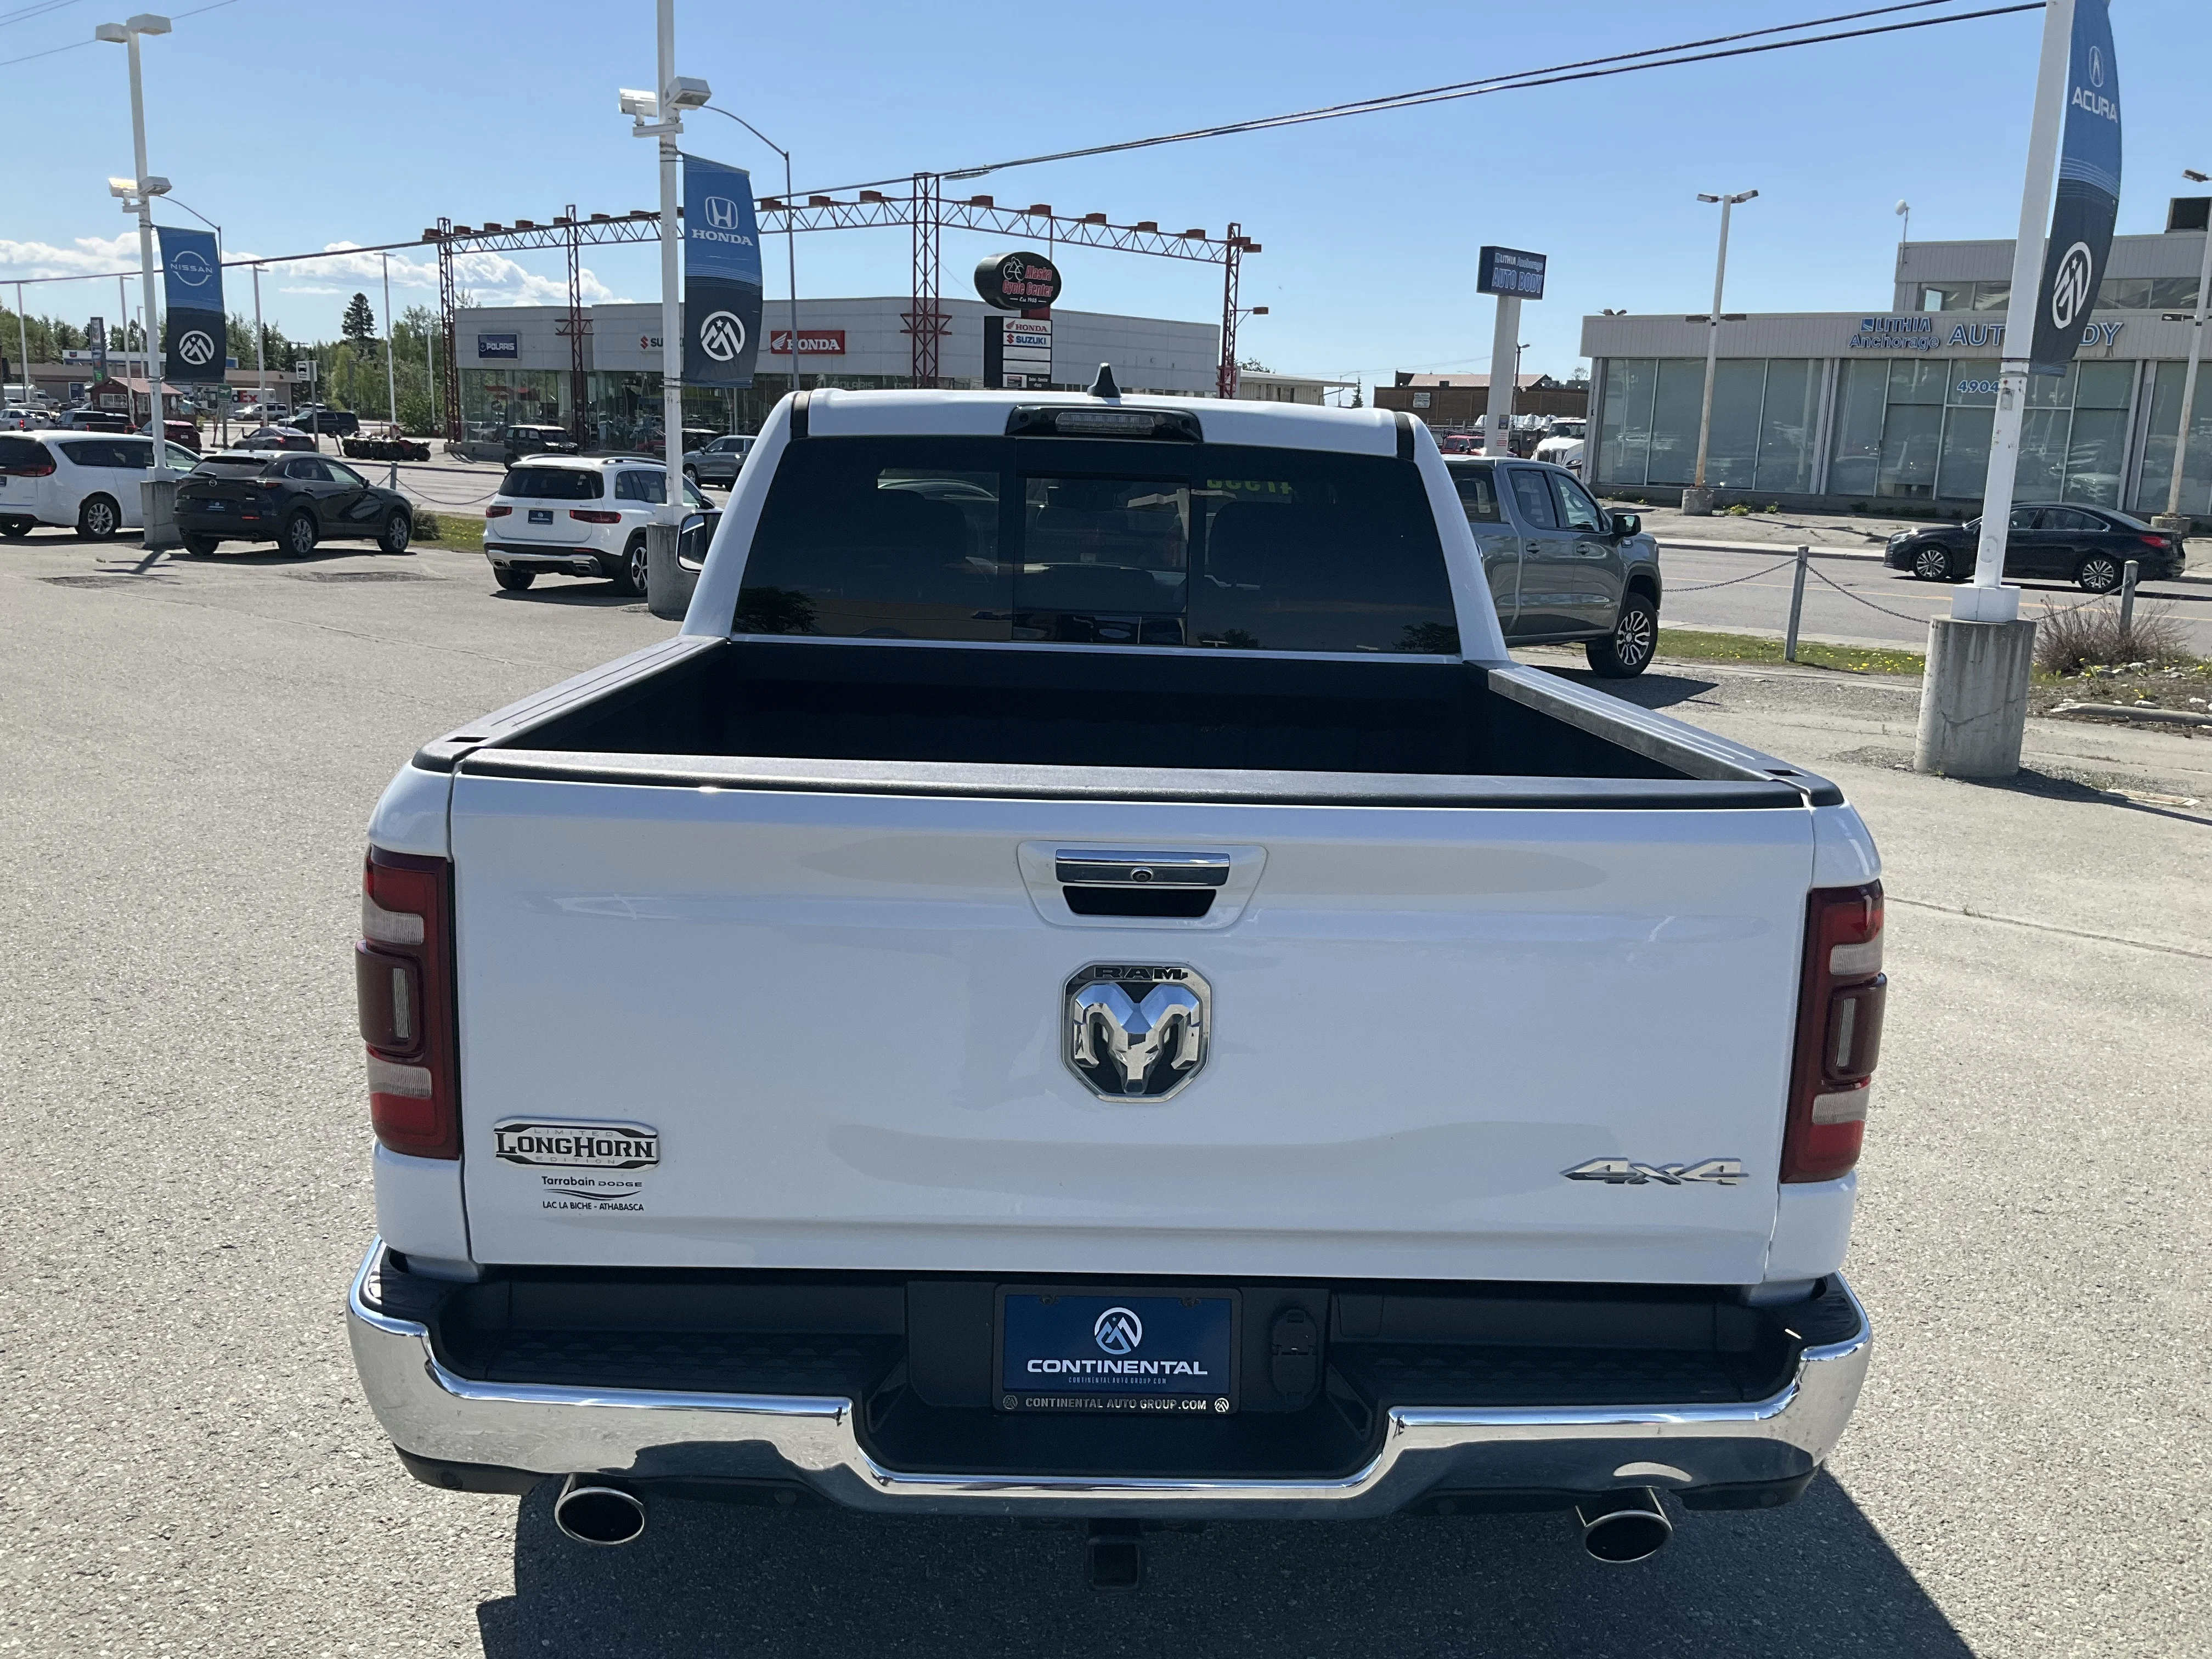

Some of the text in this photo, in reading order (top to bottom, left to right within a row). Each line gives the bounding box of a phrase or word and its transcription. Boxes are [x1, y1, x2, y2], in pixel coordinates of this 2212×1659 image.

[2072, 87, 2118, 123] ACURA
[691, 229, 753, 246] HONDA
[1500, 254, 1516, 266] LITHIA
[170, 263, 213, 273] NISSAN
[1024, 265, 1053, 281] Alaska
[1492, 267, 1543, 294] AUTO BODY
[1002, 279, 1053, 297] Cycle Center
[1015, 324, 1047, 332] HONDA
[1876, 317, 1931, 332] LITHIA
[1015, 335, 1046, 345] SUZUKI
[1947, 322, 2124, 347] AUT DY
[487, 342, 515, 351] POLARIS
[787, 338, 840, 351] HONDA
[1848, 333, 1940, 352] Anchorage
[1956, 380, 2001, 394] 4904
[232, 390, 258, 403] dEx
[1094, 967, 1182, 979] RAM
[534, 1128, 613, 1137] LIMITED
[495, 1133, 654, 1158] LONGHORN
[536, 1156, 615, 1165] EDITION
[541, 1176, 595, 1186] Tarrabain
[1027, 1359, 1208, 1375] CONTINENTAL
[1025, 1398, 1103, 1408] CONTINENTAL
[1107, 1399, 1137, 1408] AUTO
